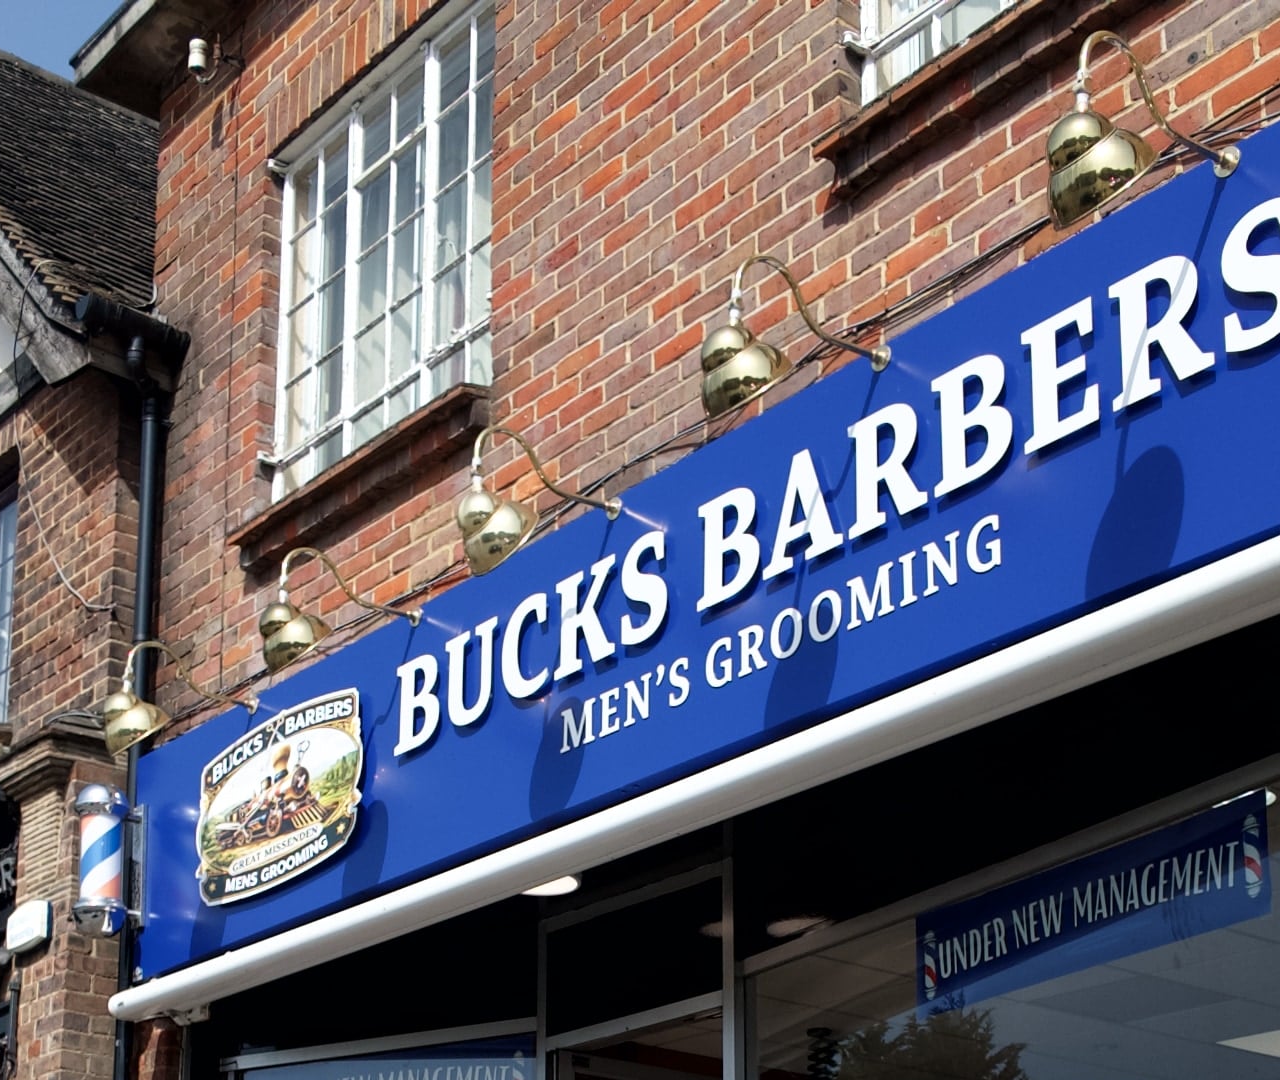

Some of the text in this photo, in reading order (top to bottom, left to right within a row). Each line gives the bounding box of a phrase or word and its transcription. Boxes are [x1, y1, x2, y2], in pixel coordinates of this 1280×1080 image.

[394, 530, 666, 757] BUCKS
[705, 514, 1002, 688] GROOMING
[213, 698, 352, 785] BUCKS BARBERS
[225, 835, 328, 893] MENS GROOMING
[232, 826, 318, 872] GREAT MISSENDEN
[938, 841, 1240, 979] UNDER NEW MANAGEMENT
